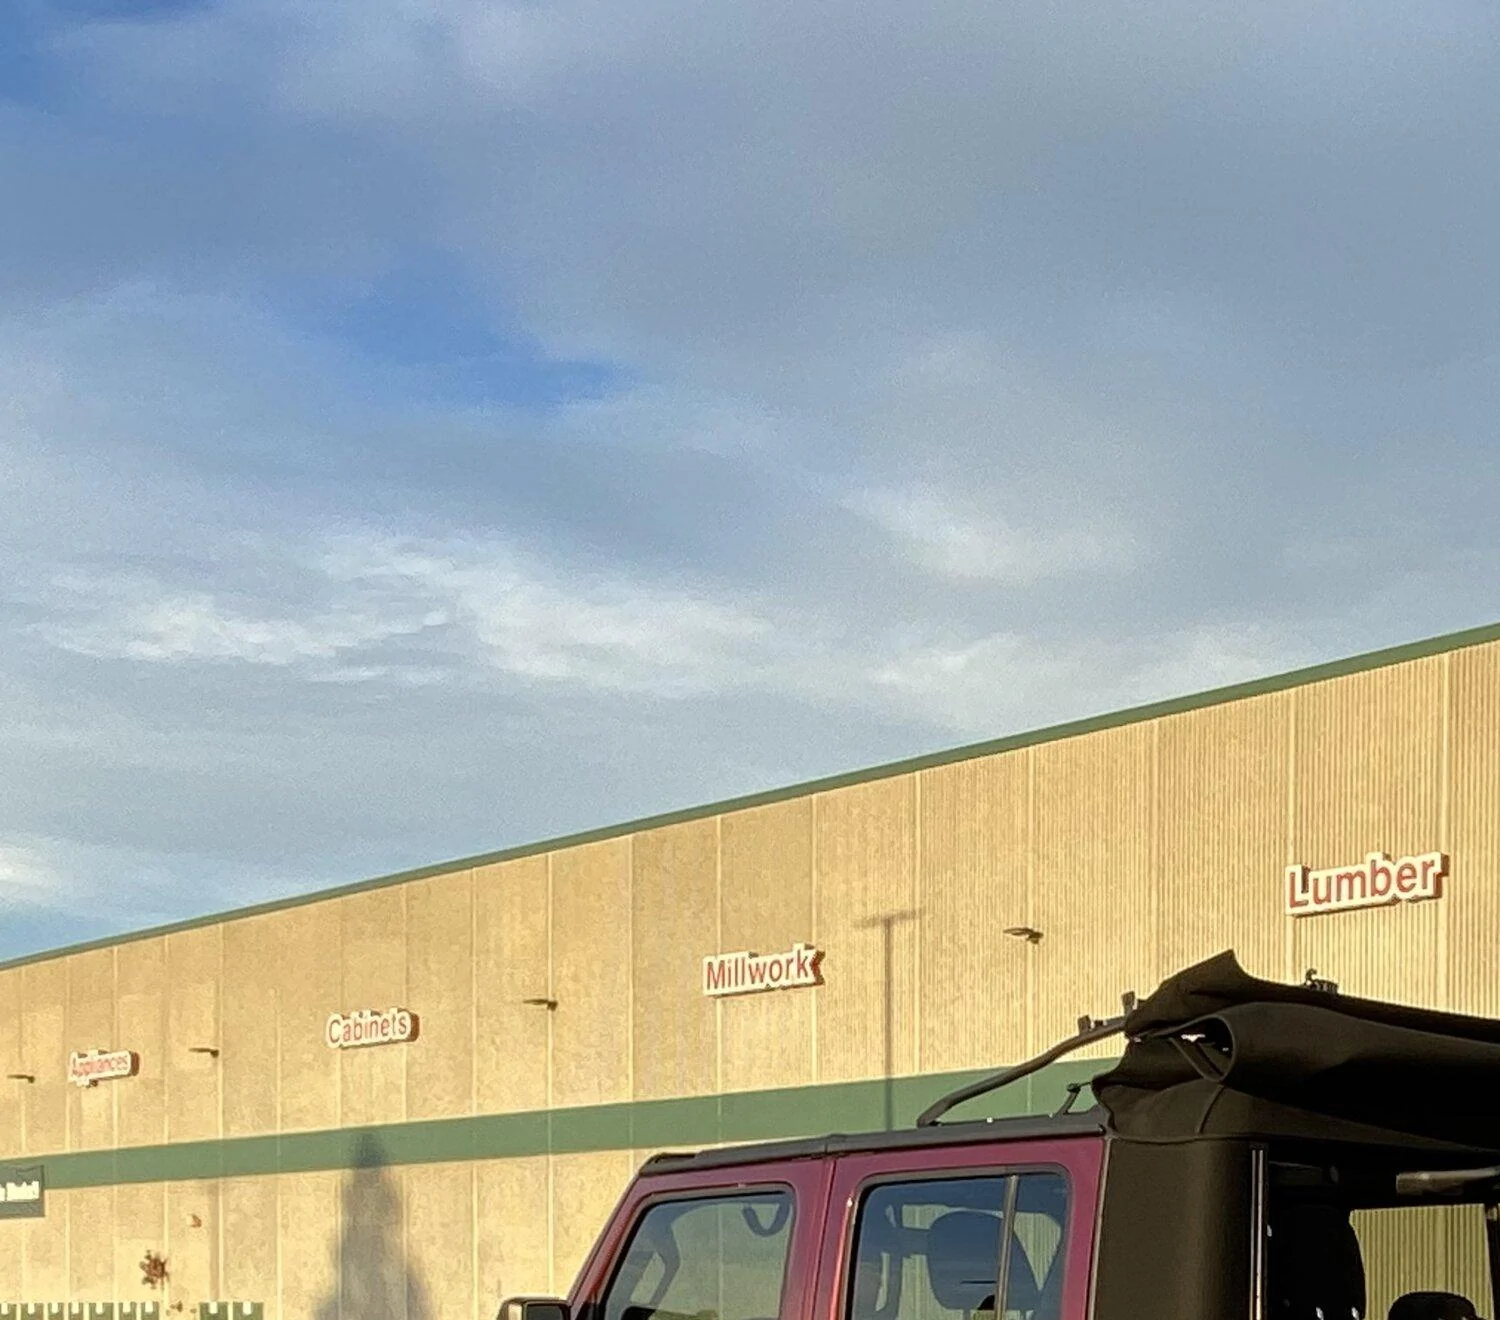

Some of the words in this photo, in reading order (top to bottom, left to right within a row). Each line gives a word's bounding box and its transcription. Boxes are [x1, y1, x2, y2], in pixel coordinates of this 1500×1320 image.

[1288, 859, 1435, 908] Lumber
[706, 949, 808, 990] Millwork
[328, 1013, 407, 1043] Cabinets
